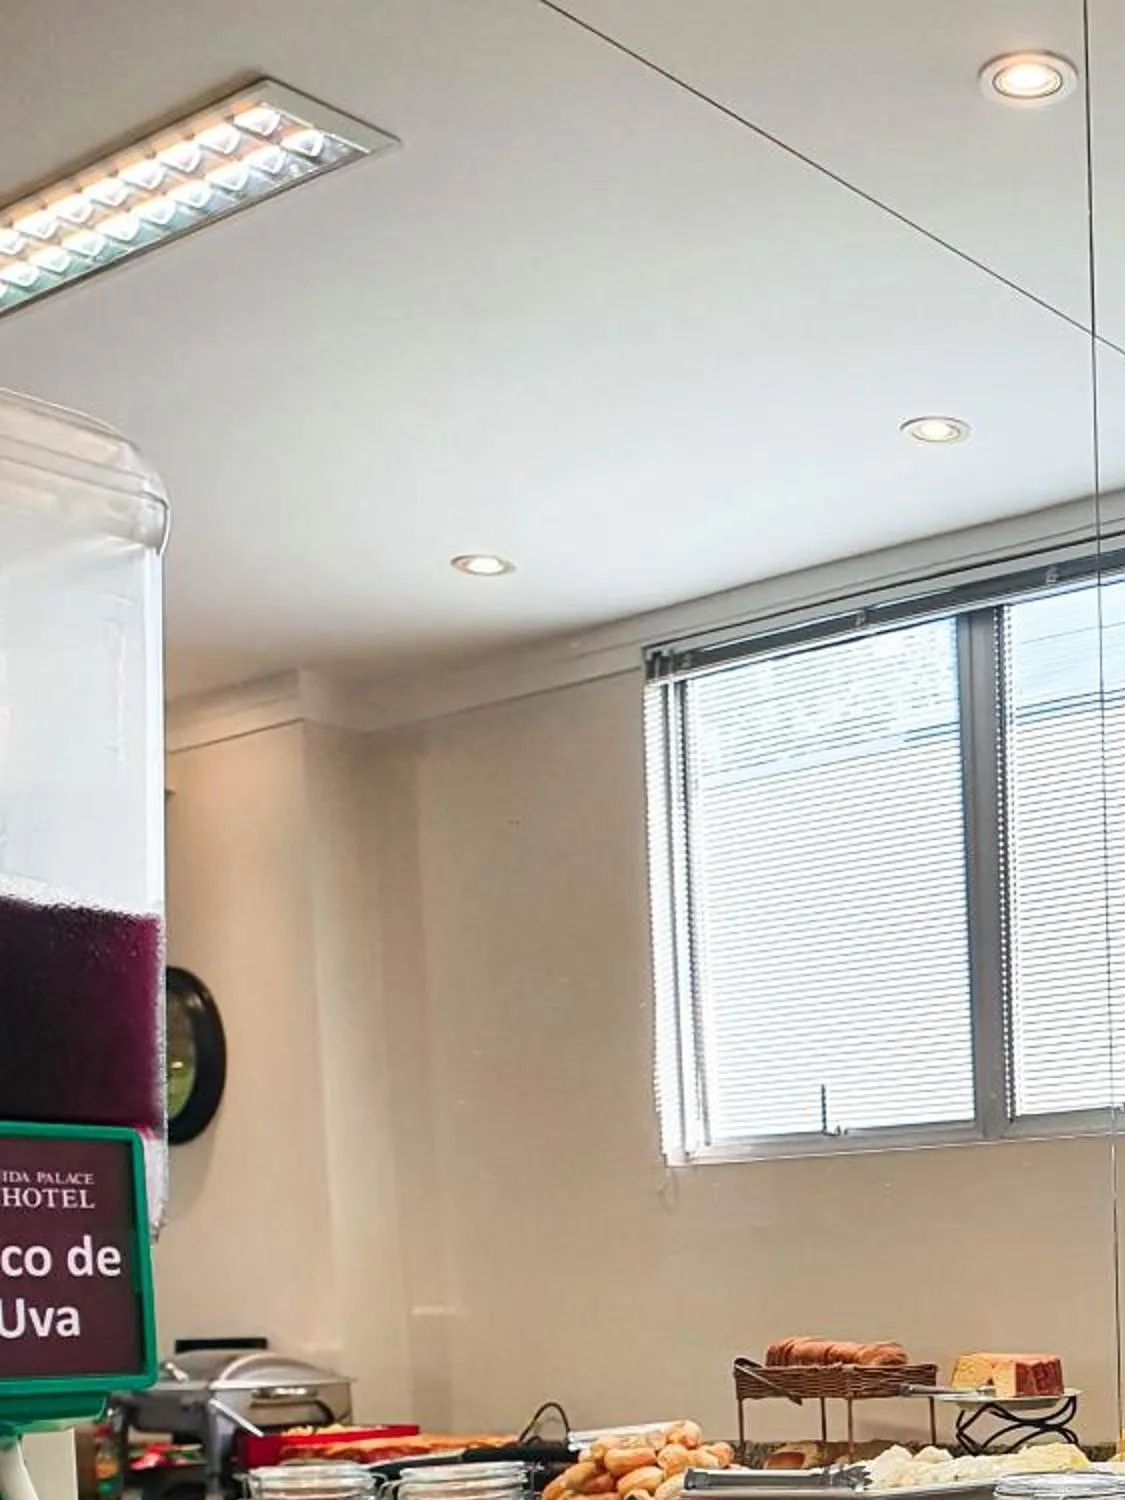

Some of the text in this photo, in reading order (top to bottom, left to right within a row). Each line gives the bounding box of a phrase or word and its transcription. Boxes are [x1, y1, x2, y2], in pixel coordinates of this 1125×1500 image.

[0, 1171, 95, 1185] IDA PALACE
[3, 1187, 96, 1209] HOTEL
[0, 1234, 121, 1277] co de
[0, 1298, 80, 1339] Uva
